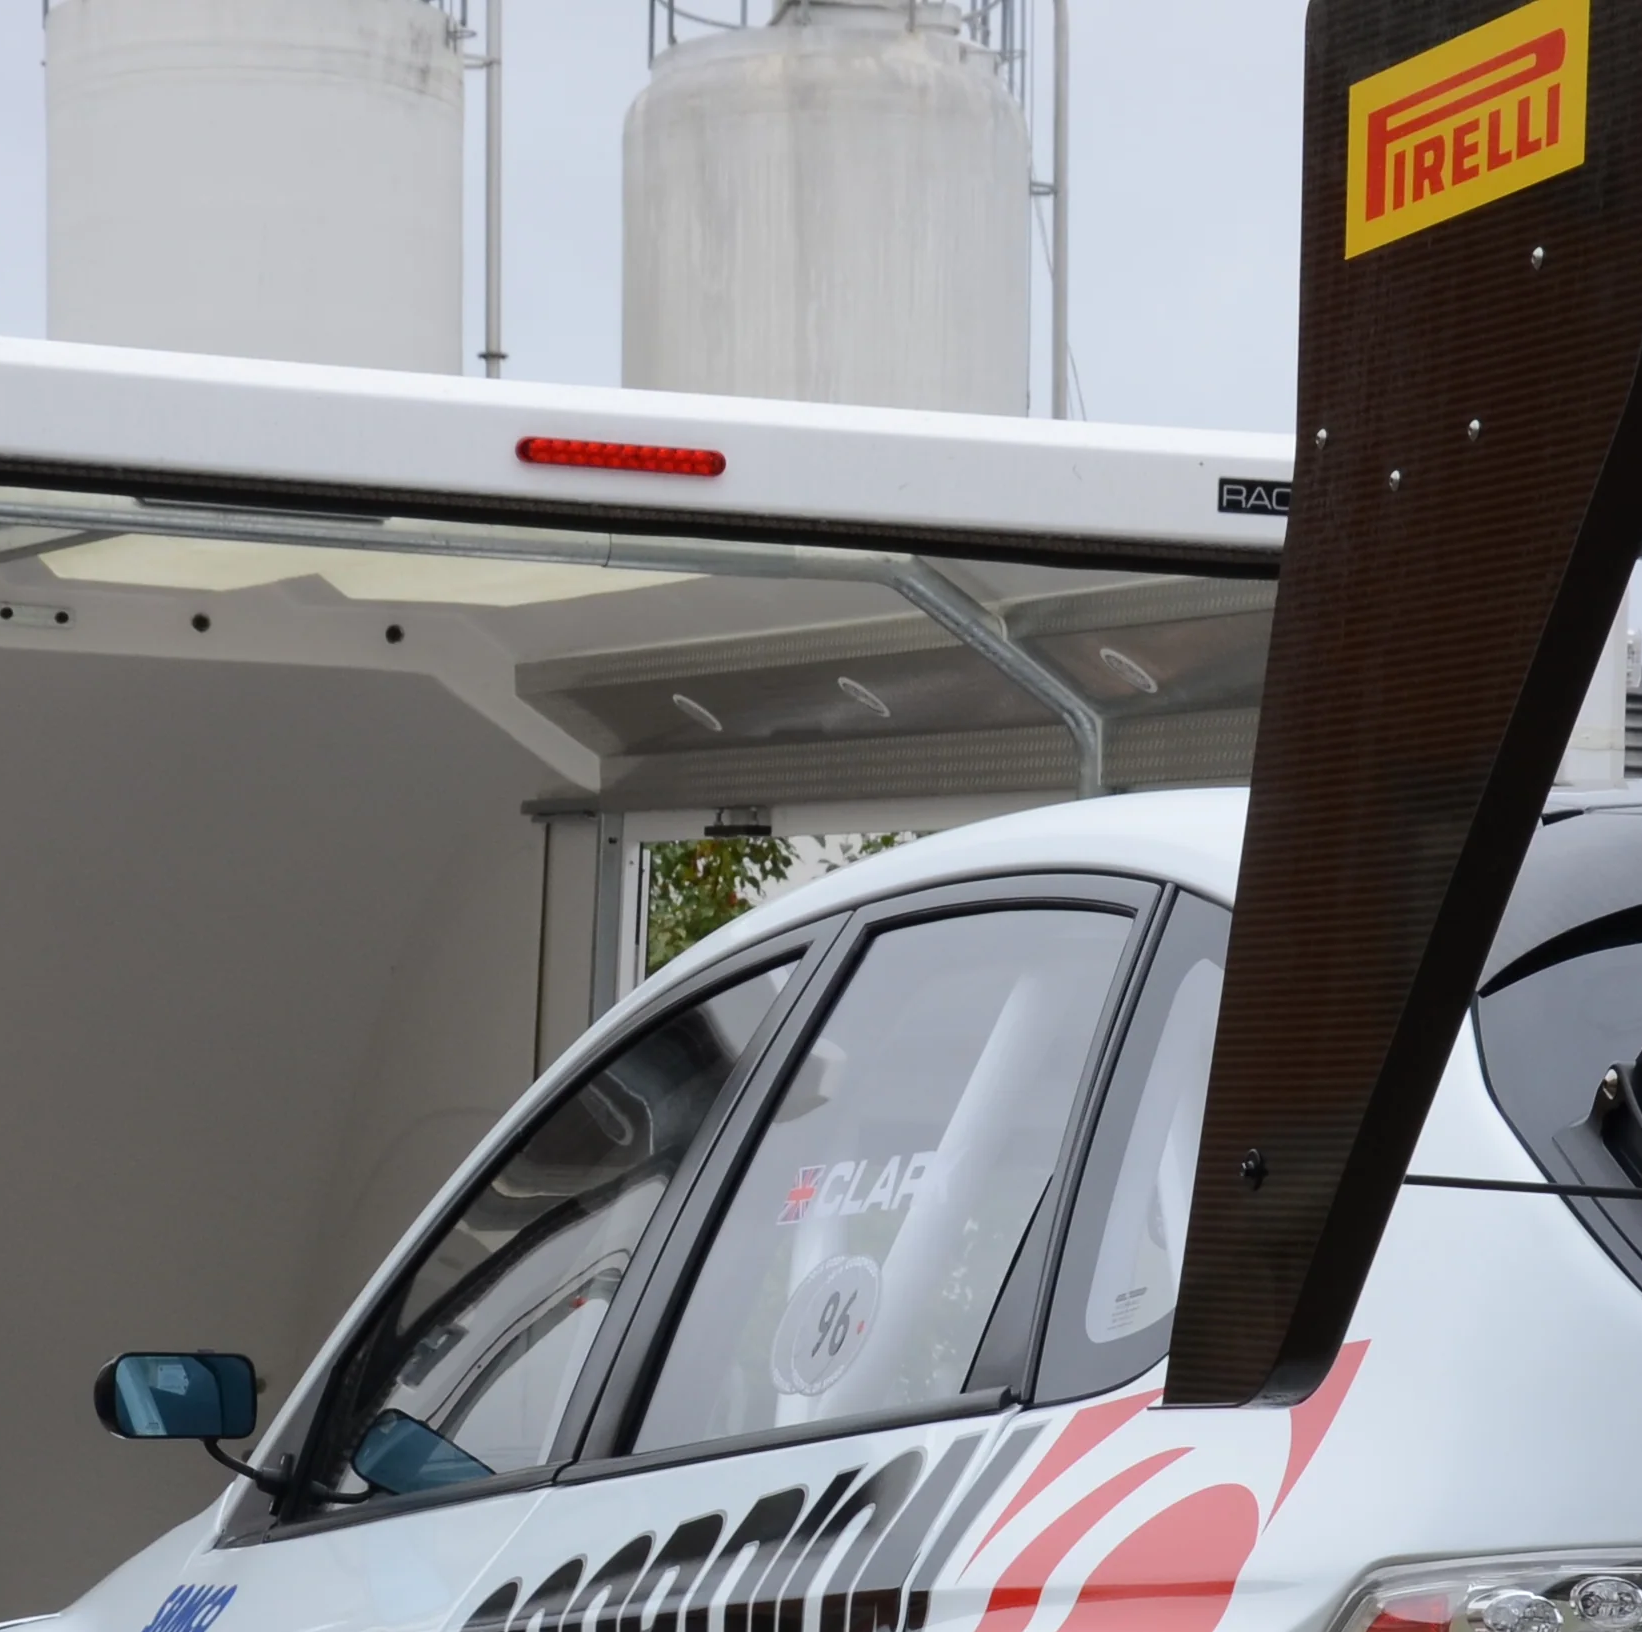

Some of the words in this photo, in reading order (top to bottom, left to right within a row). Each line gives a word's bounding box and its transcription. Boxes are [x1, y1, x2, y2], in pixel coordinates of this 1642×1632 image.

[1365, 27, 1566, 223] PIRELLI
[815, 1151, 949, 1217] CLAR
[810, 1287, 859, 1358] 96
